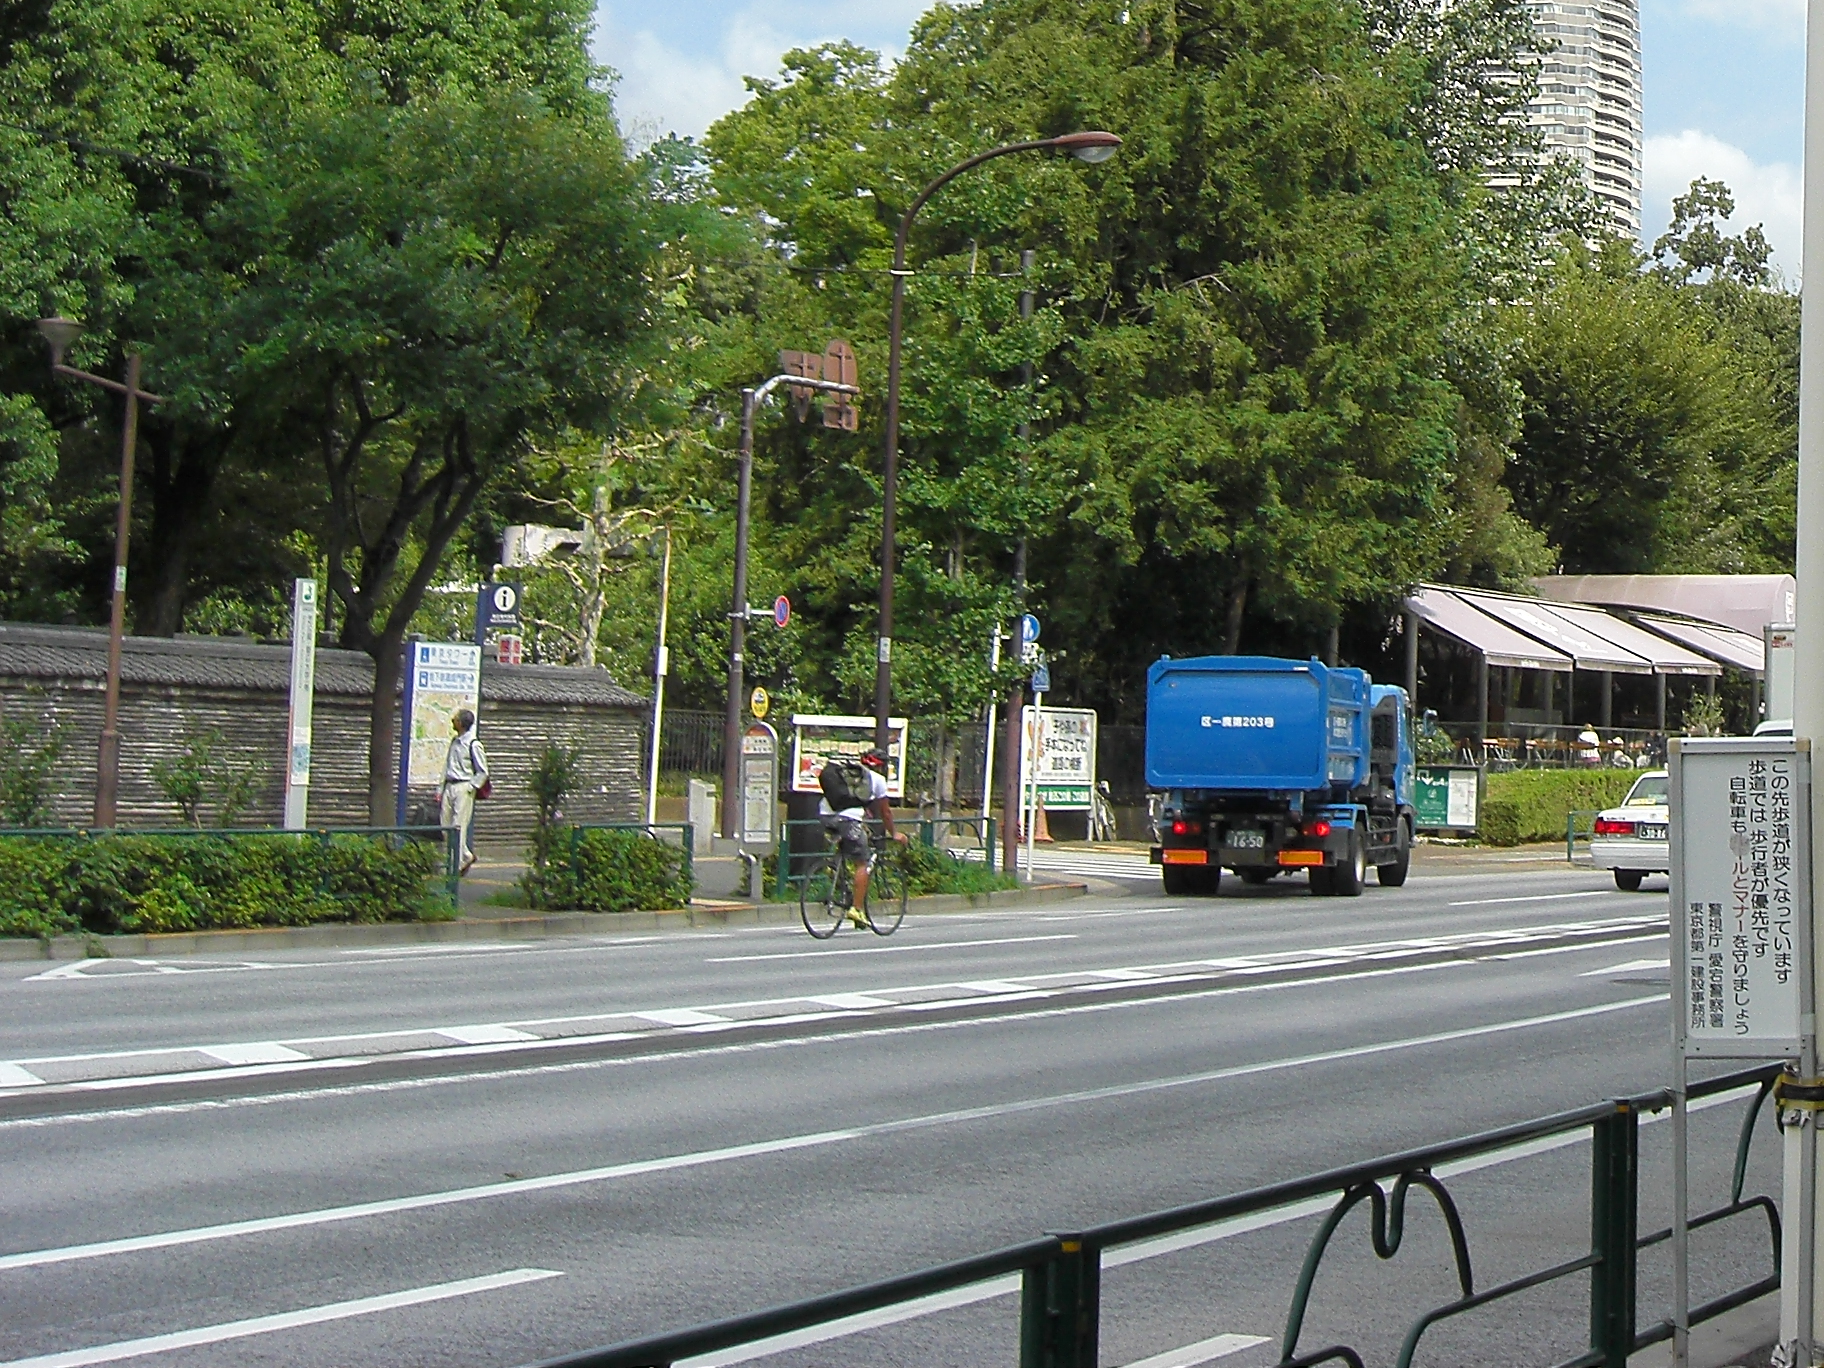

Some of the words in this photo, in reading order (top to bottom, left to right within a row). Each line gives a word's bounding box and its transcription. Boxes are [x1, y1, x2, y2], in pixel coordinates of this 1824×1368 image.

[1729, 776, 1749, 1035] 自転車もルとマナーを守りましょう
[1771, 759, 1792, 985] この先歩道が狭くなっています
